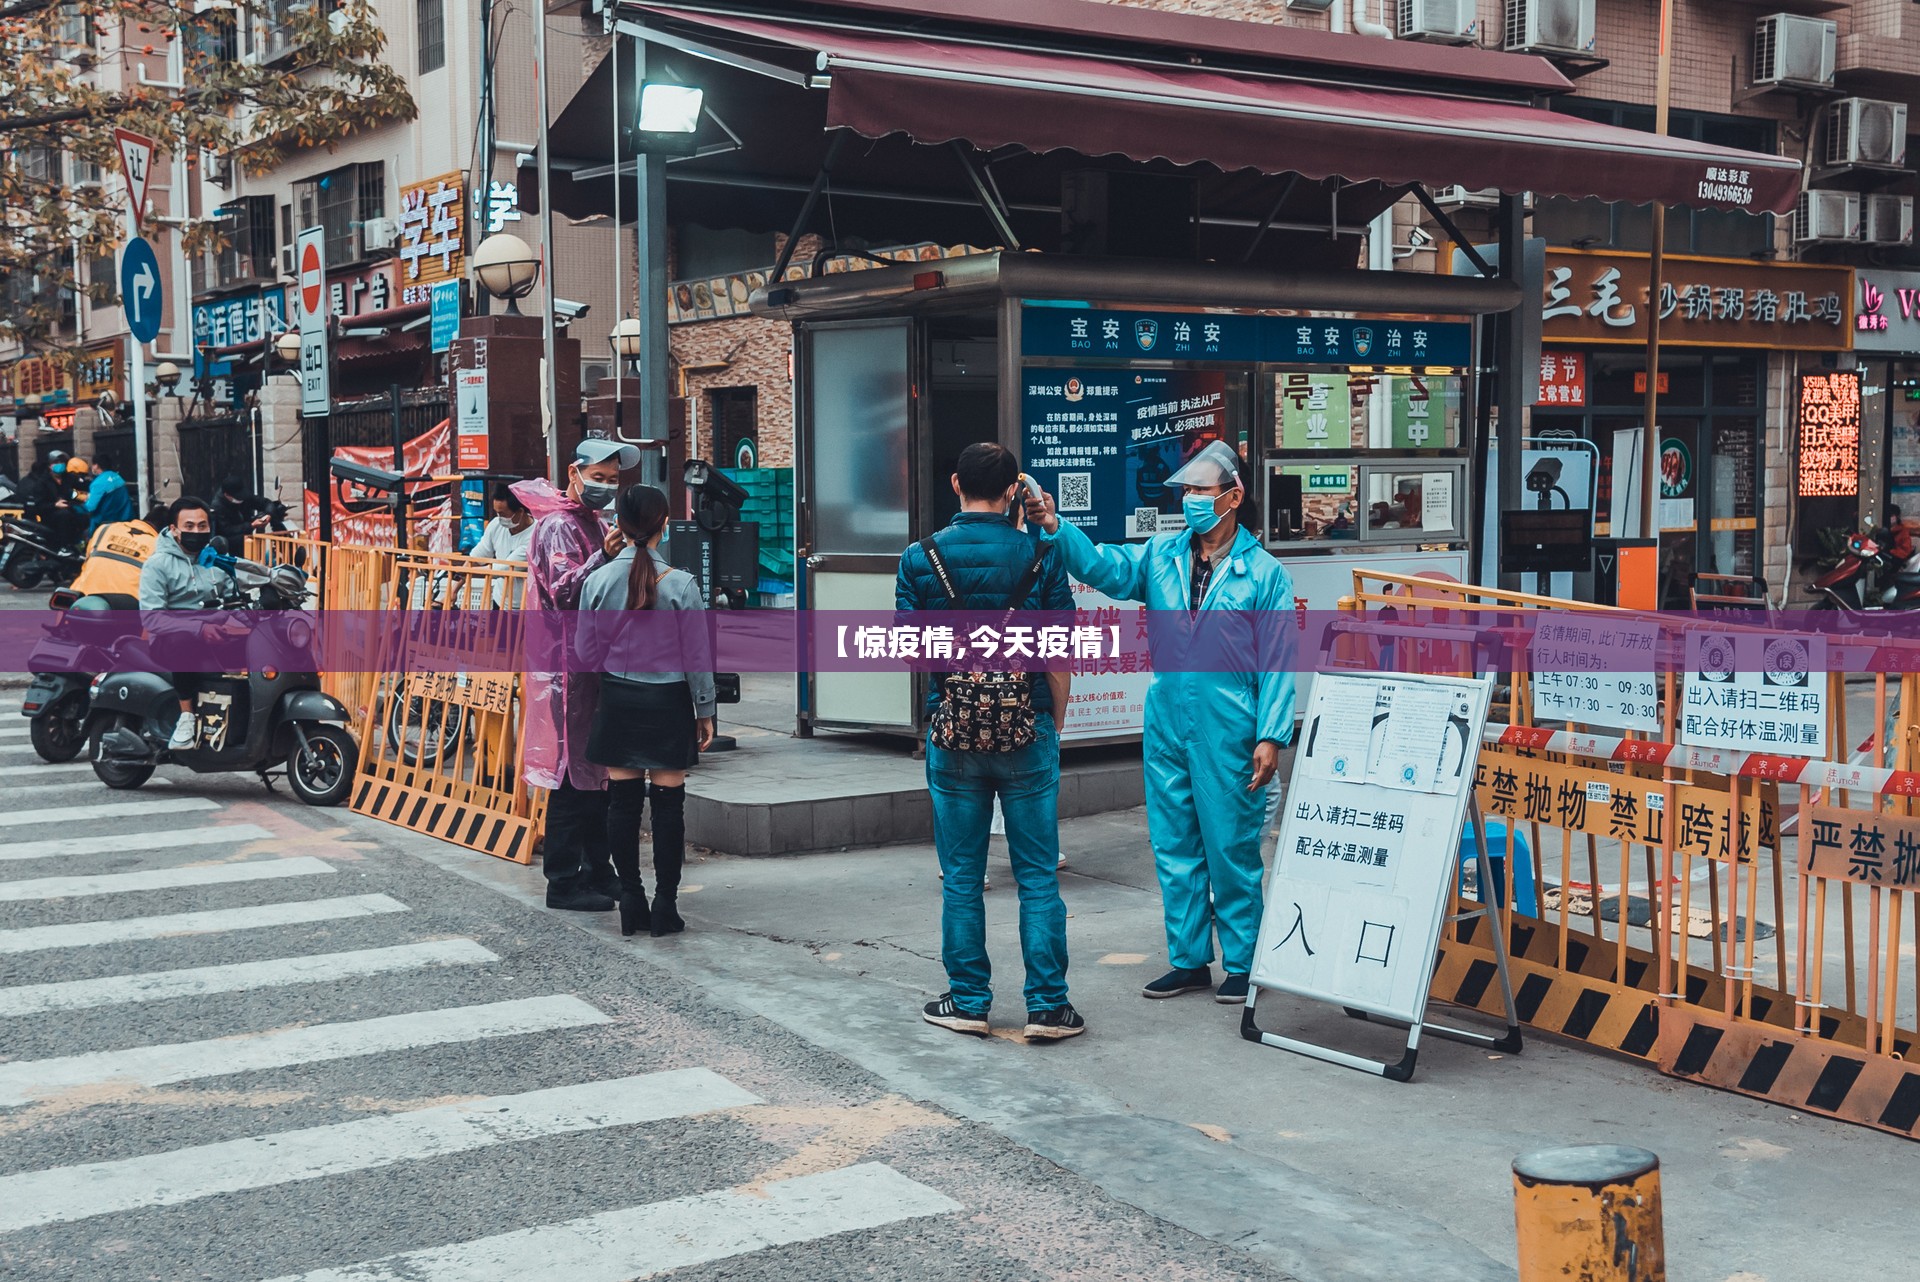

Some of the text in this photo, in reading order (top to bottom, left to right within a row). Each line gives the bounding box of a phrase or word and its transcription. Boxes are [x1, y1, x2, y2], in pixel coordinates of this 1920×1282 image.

[129, 149, 144, 182] 让
[1698, 181, 1753, 204] 13049366536
[400, 182, 458, 279] 学车
[1542, 267, 1636, 327] 三毛
[1898, 288, 1920, 319] V
[305, 344, 322, 371] 出口
[1071, 340, 1218, 352] BAO AN ZHI AN
[1297, 347, 1426, 358] BAO AN ZHI AN
[1540, 355, 1578, 382] 春节
[308, 377, 321, 392] EXIT
[1028, 385, 1119, 397] 深圳公安 郑重提示
[1136, 392, 1221, 420] 疫情当前 执法从严
[1805, 402, 1855, 425] QQ美甲
[1130, 413, 1216, 442] 事关人人 必须较真
[1618, 680, 1654, 697] 09:30
[1687, 685, 1820, 714] 出入请扫二维码
[1078, 707, 1092, 718] 民主
[1095, 706, 1109, 716] 文明
[1112, 705, 1127, 714] 和谐
[1130, 704, 1143, 713] 自由
[1620, 702, 1656, 718] 20:30
[1686, 714, 1819, 745] 配合好体温测量
[1508, 737, 1535, 746] SAFE
[1567, 745, 1595, 754] CAUTION
[1623, 751, 1653, 761] SAFE
[1689, 760, 1719, 770] CAUTION
[1751, 767, 1784, 778] SAFE
[1825, 776, 1860, 787] CAUTION
[1473, 764, 1587, 831] 严禁抛物
[1295, 801, 1404, 834] 出入请扫二维码
[1295, 835, 1389, 868] 配合体温测量
[1808, 819, 1920, 886] 严禁抛
[1272, 902, 1396, 968] 入 口
